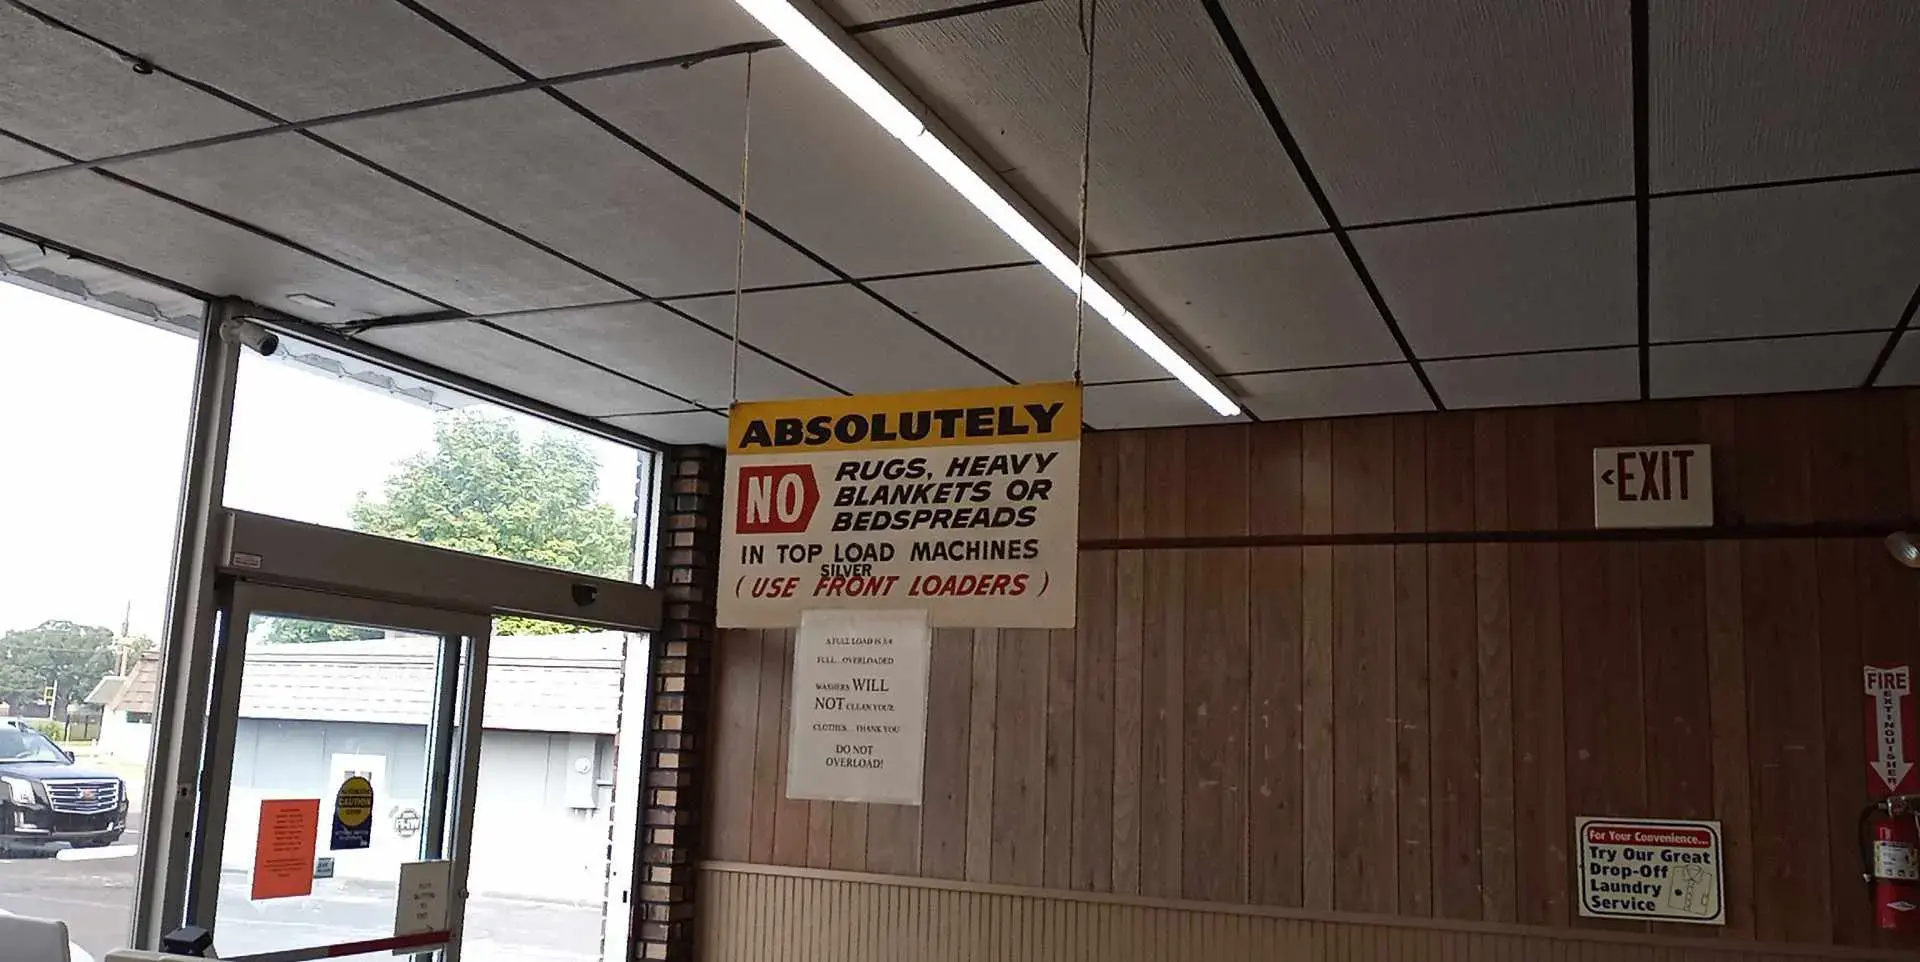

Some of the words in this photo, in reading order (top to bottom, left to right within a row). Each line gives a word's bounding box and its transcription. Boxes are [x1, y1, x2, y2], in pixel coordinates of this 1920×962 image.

[739, 402, 1064, 449] ABSOLUTELY
[834, 457, 933, 482] RUGS,
[946, 452, 1059, 477] HEAVY
[1617, 450, 1694, 501] EXIT
[746, 473, 805, 525] NO
[833, 480, 992, 508] BLANKETS
[1005, 479, 1053, 501] OR
[831, 505, 1037, 532] BEDSPREADS
[741, 545, 764, 565] IN
[776, 543, 822, 563] TOP
[834, 541, 895, 563] LOAD
[909, 538, 1039, 562] MACHINES
[820, 563, 872, 578] SILVER
[813, 575, 899, 597] FRONT
[852, 678, 890, 692] WILL
[1867, 673, 1906, 689] FIRE
[815, 697, 846, 710] NOT
[836, 744, 851, 754] DO
[852, 745, 873, 755] NOT
[825, 757, 884, 769] OVERLOAD!
[1589, 830, 1606, 840] For
[1609, 831, 1632, 841] Your
[1589, 846, 1617, 862] Try
[1623, 848, 1654, 861] Our
[1660, 850, 1711, 864] Great
[1590, 863, 1668, 879] Drop-Off
[1590, 879, 1662, 898] Laundry
[1591, 896, 1656, 911] Service
